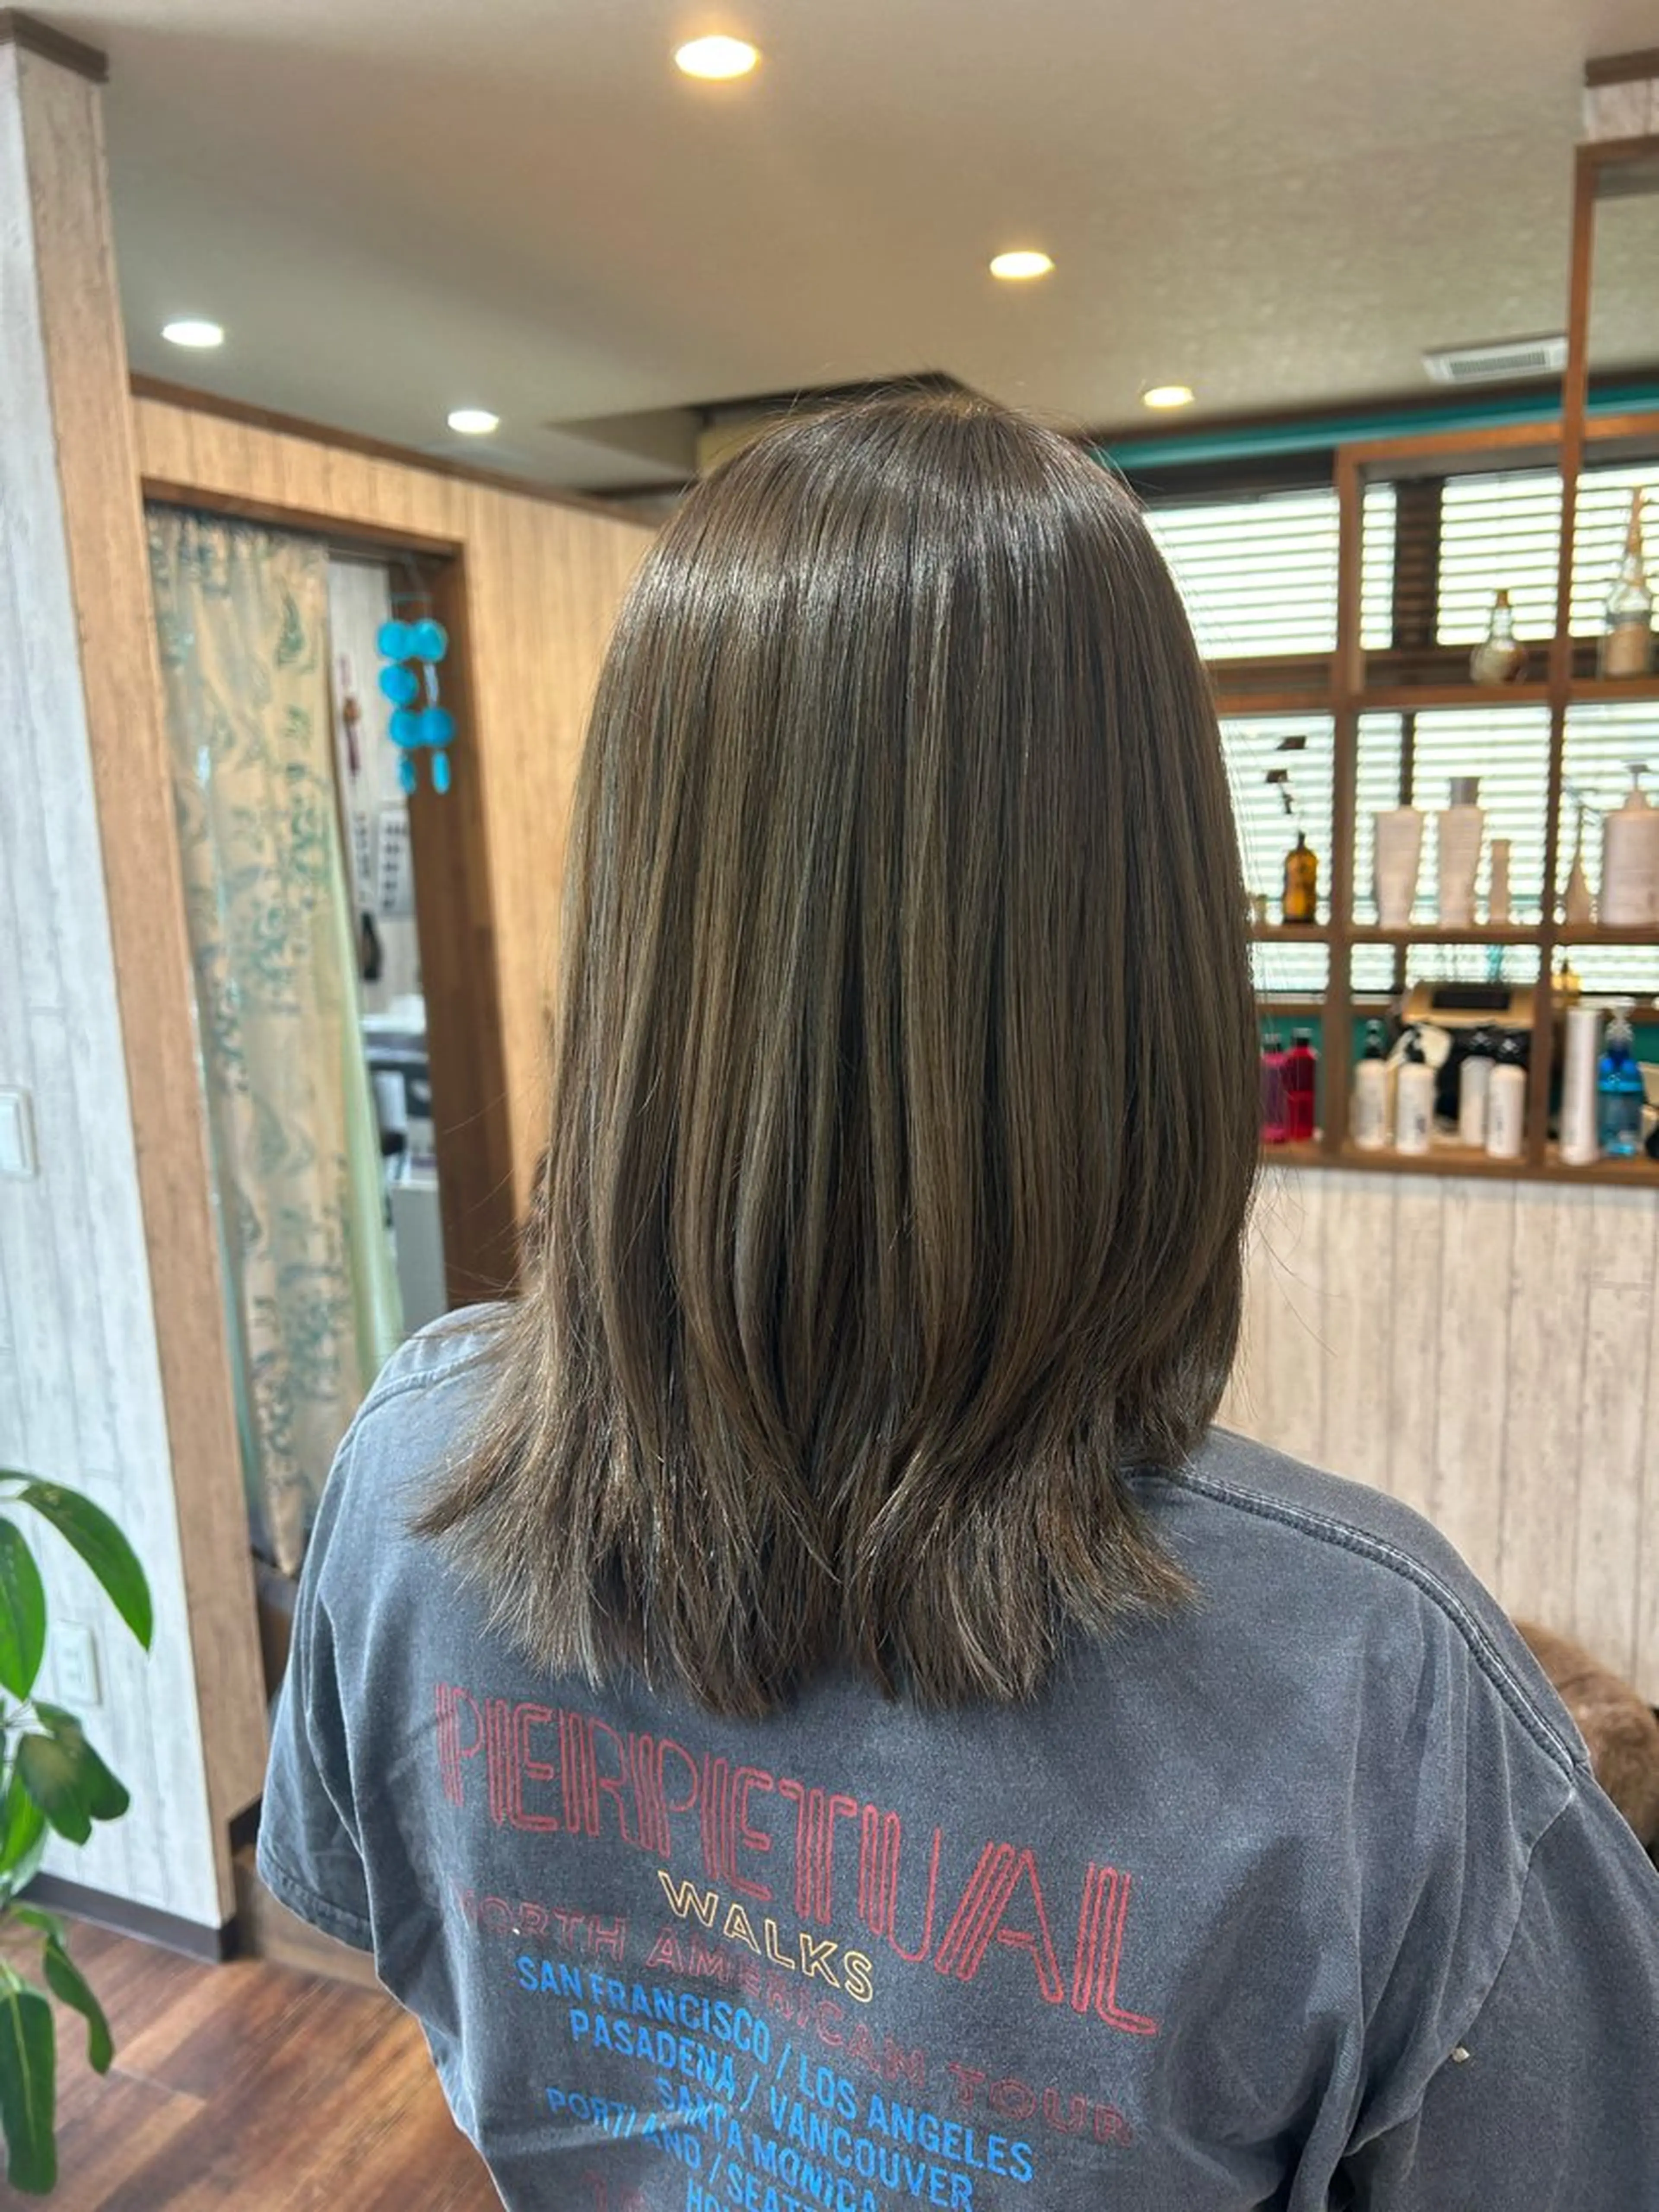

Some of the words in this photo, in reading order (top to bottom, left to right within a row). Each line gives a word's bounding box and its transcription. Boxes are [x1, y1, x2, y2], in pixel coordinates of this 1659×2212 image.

[436, 1682, 1158, 2035] PERPETUAL
[658, 1870, 873, 2002] WALKS
[517, 1955, 583, 2001] SAN
[589, 1973, 770, 2064] FRANCISCO
[799, 2054, 857, 2120] LOS
[868, 2092, 1034, 2183] ANGELES
[569, 2008, 735, 2102] PASADENA
[770, 2086, 973, 2212] VANCOUVER
[948, 2061, 1132, 2148] TOUR
